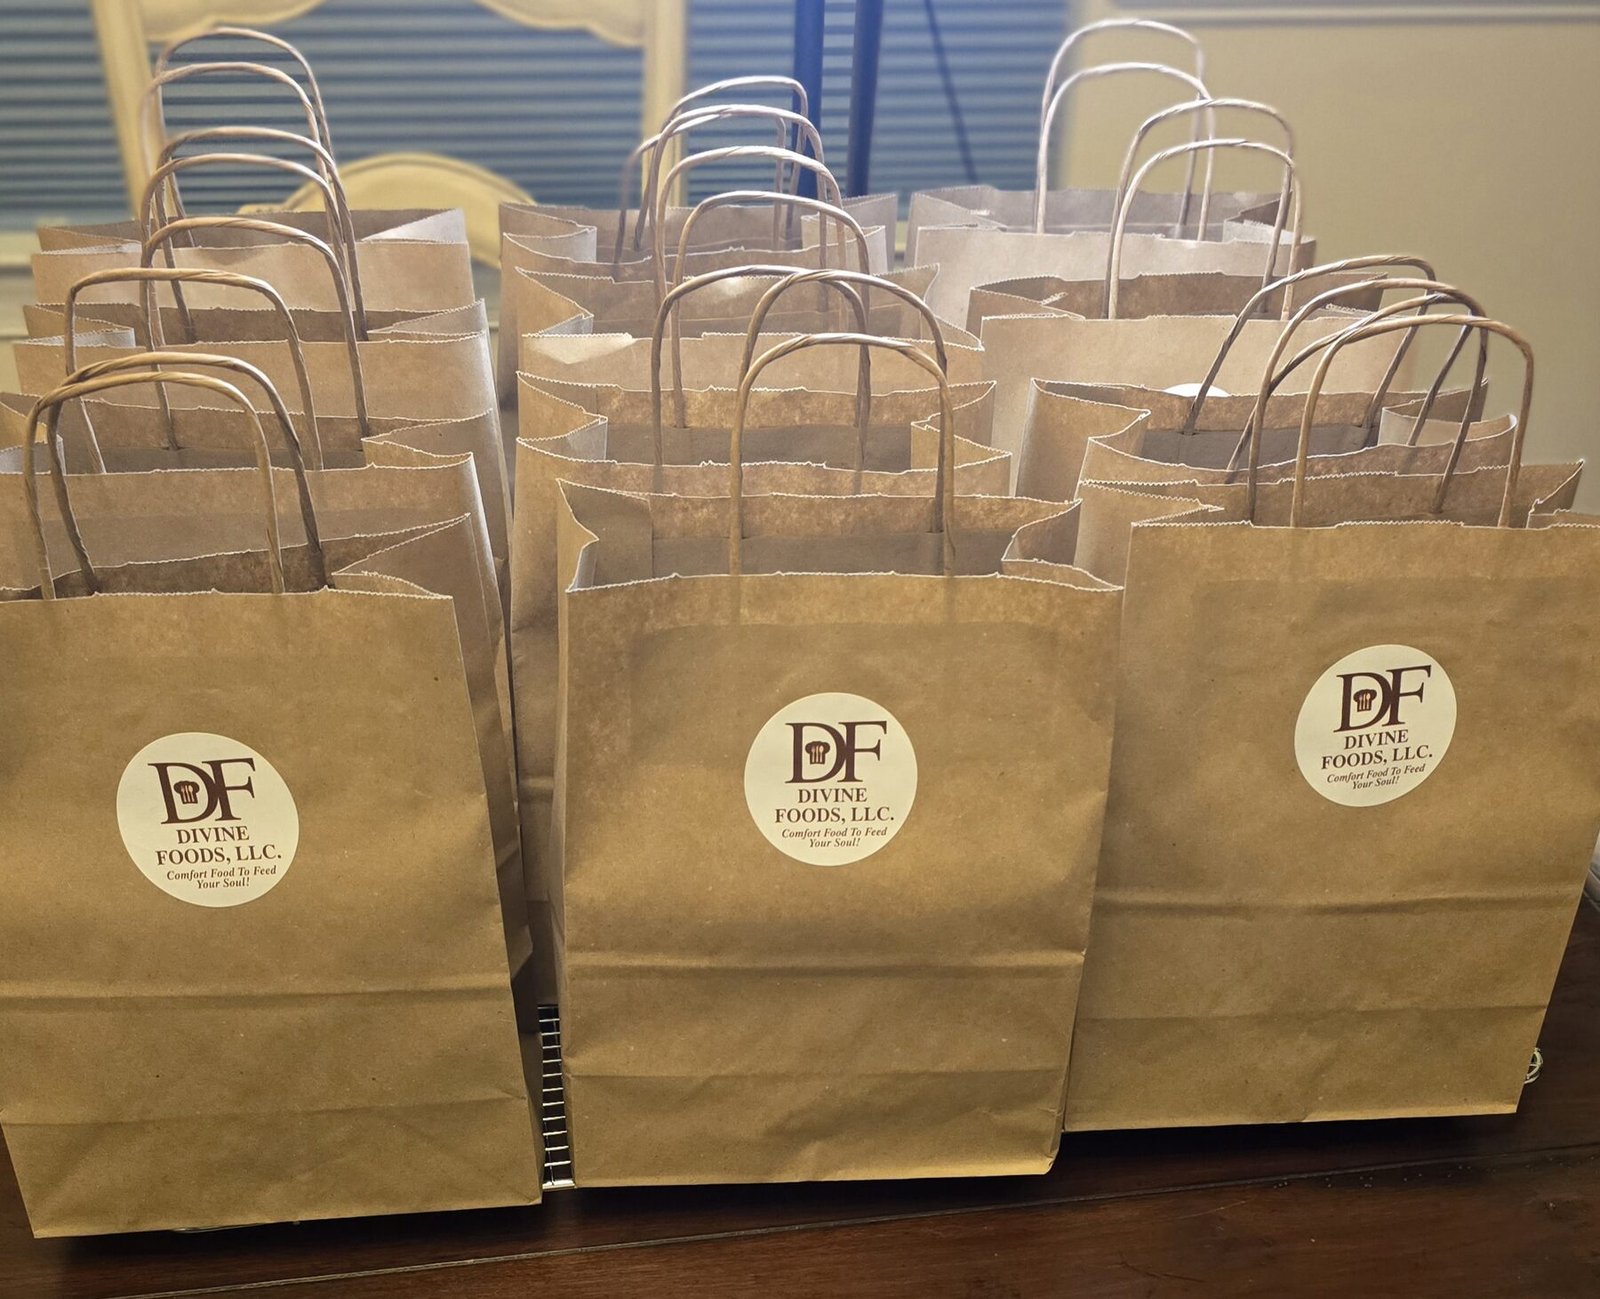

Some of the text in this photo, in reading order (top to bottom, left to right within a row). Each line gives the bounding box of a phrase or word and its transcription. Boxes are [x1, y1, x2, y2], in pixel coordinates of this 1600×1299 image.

[1333, 665, 1431, 733] DF
[1344, 729, 1408, 750] DIVINE
[784, 721, 887, 783] DF
[1321, 745, 1432, 770] FOODS, LLC.
[1327, 764, 1425, 783] Comfort Food To Feed
[148, 758, 255, 824] DF
[1352, 776, 1399, 790] Your Soul!
[798, 788, 867, 803] DIVINE
[775, 807, 894, 824] FOODS, LLC.
[176, 826, 250, 844] DIVINE
[782, 827, 887, 840] Comfort Food To Feed
[809, 838, 860, 847] Your Soul!
[155, 844, 282, 865] FOODS, LLC.
[167, 865, 276, 881] Comfort Food To Feed
[197, 878, 250, 889] Your Soul!
